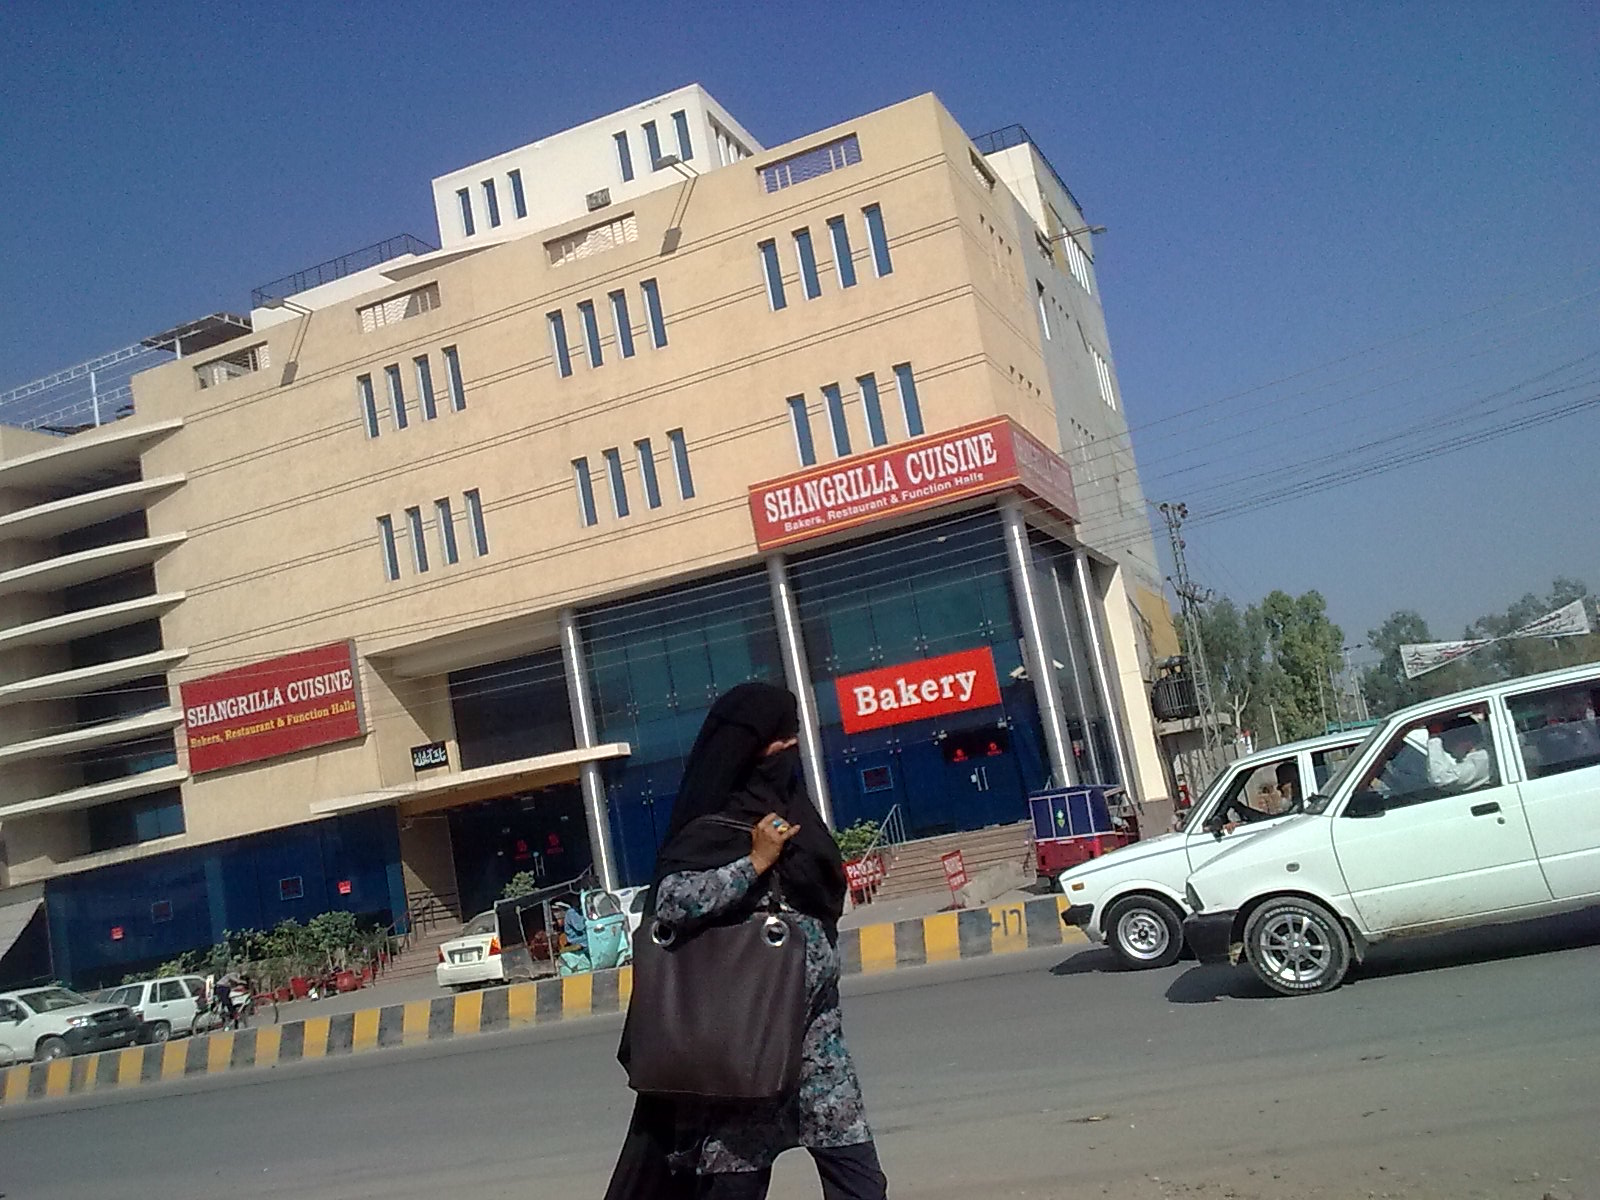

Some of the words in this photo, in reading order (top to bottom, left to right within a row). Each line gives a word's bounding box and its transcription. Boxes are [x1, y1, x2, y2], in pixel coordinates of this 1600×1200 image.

[764, 460, 899, 523] SHANGRILLA
[905, 432, 997, 484] CUISINE
[784, 516, 826, 532] Bakers,
[828, 498, 888, 521] Restaurant
[890, 494, 899, 504] &
[902, 481, 952, 501] Function
[955, 471, 985, 488] Halls
[187, 687, 285, 728] SHANGRILLA
[287, 669, 353, 703] CUISINE
[225, 720, 275, 741] Restaurant
[277, 717, 285, 728] &
[287, 707, 330, 725] Function
[331, 700, 357, 715] Halls
[853, 670, 977, 716] Bakery
